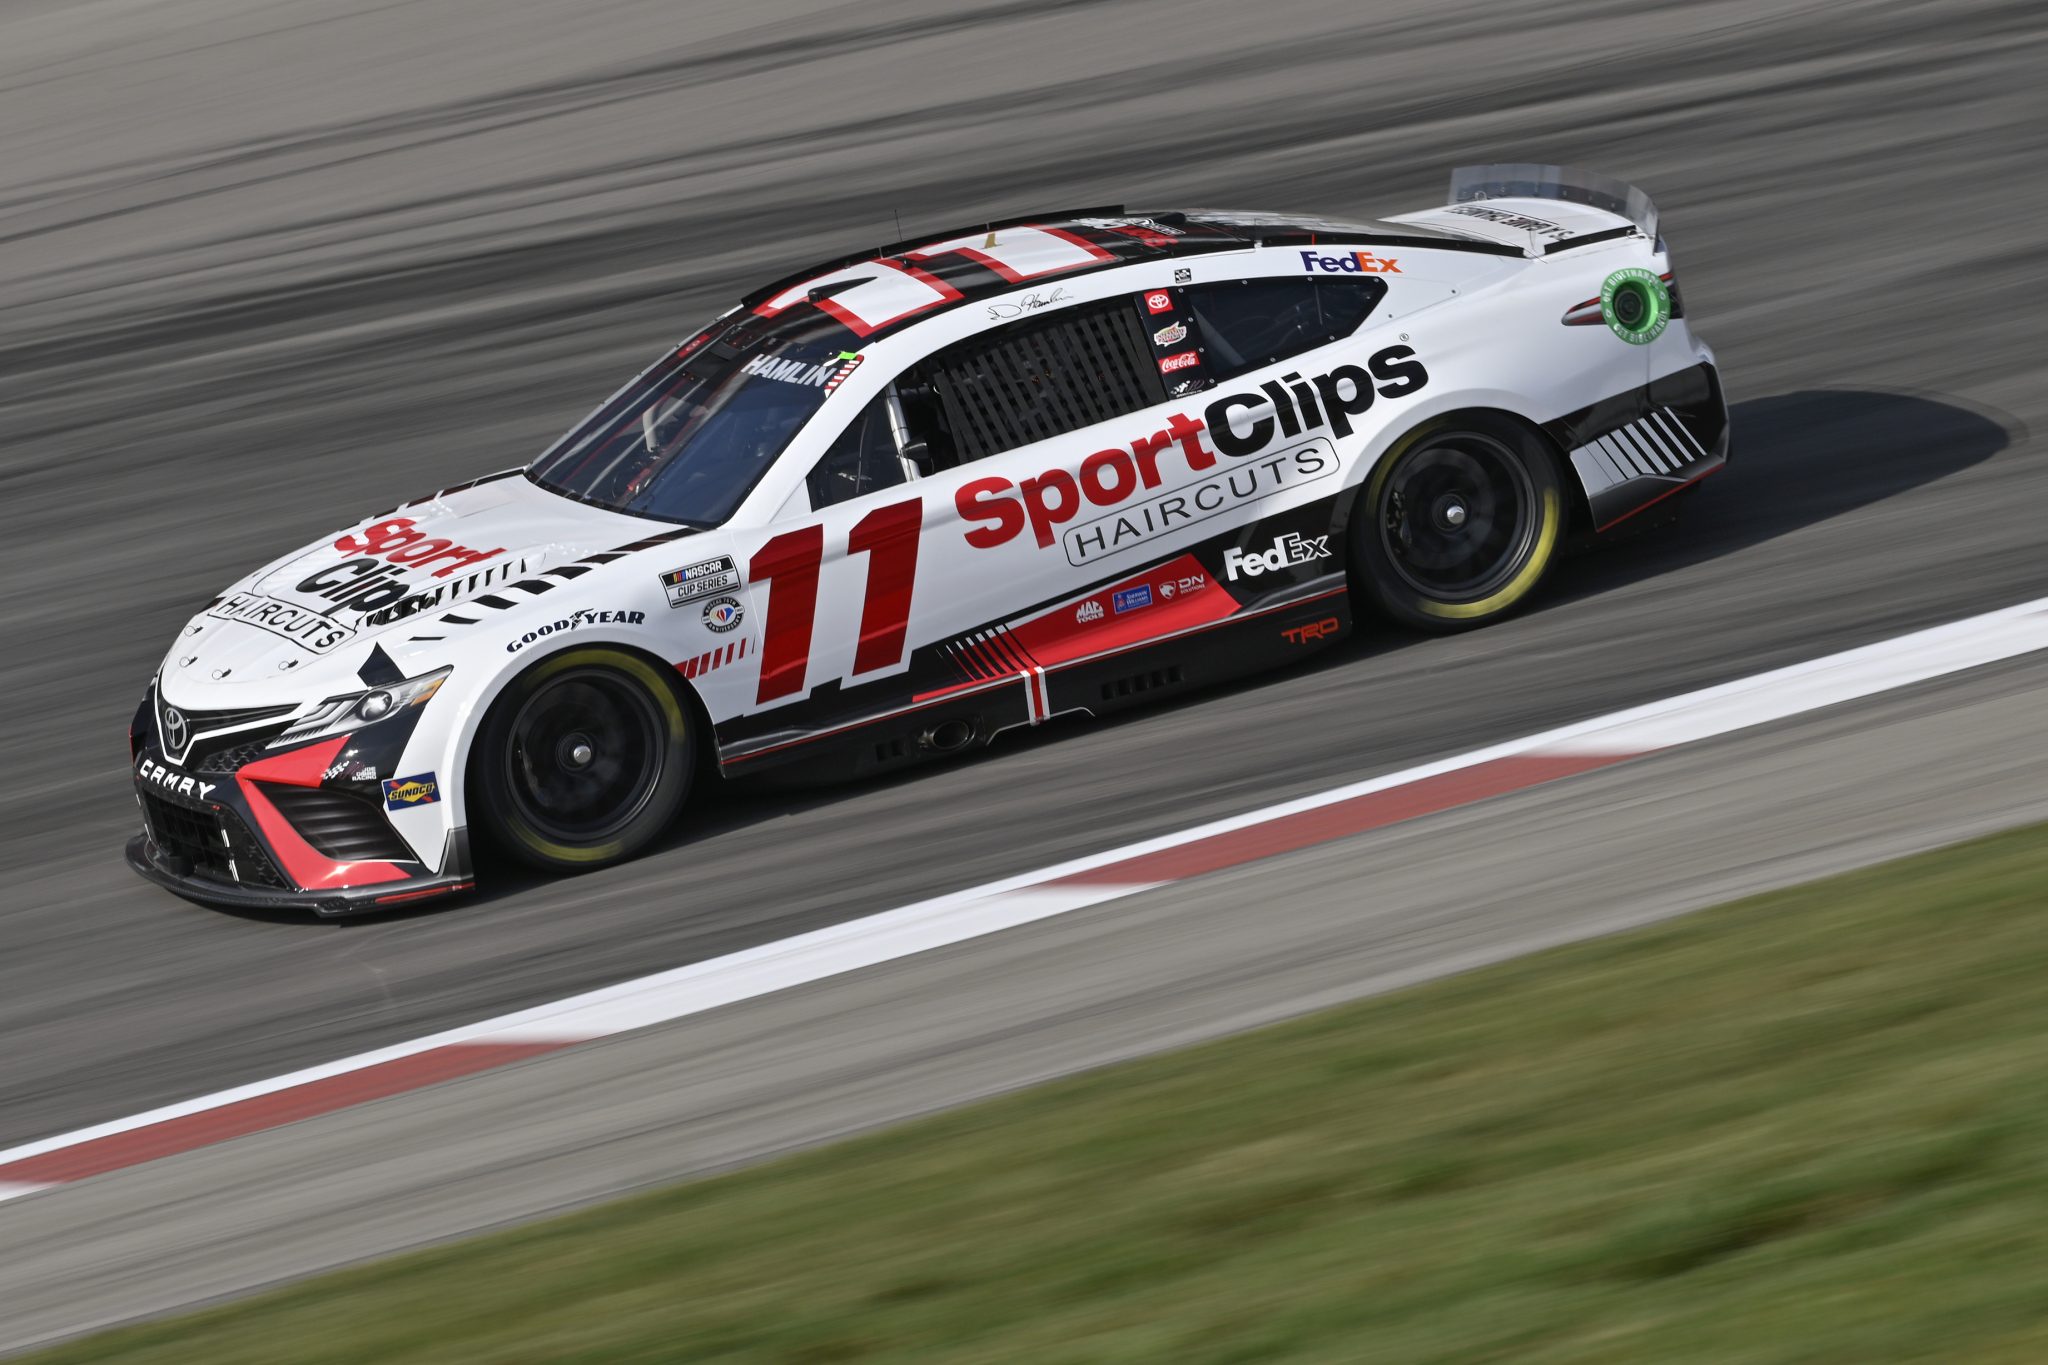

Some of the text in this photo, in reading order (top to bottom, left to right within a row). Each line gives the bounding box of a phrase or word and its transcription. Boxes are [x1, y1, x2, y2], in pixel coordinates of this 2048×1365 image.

[1300, 251, 1403, 273] FedEx
[740, 353, 837, 387] HAMLIN
[1076, 447, 1326, 558] HAIRCUTS
[333, 517, 507, 578] Sport
[1222, 532, 1331, 580] FedEx
[685, 561, 722, 580] NASCAR
[1178, 574, 1204, 588] DN
[678, 575, 728, 597] CUP SERIES
[749, 497, 923, 706] 11
[1076, 601, 1103, 618] MAC
[216, 596, 345, 648] HAIRCUTS
[506, 608, 645, 654] GOODYEAR
[1078, 613, 1105, 624] TOOLS
[1281, 617, 1338, 644] TRD
[139, 760, 217, 800] CAMRY
[391, 783, 433, 801] SUNOCO
